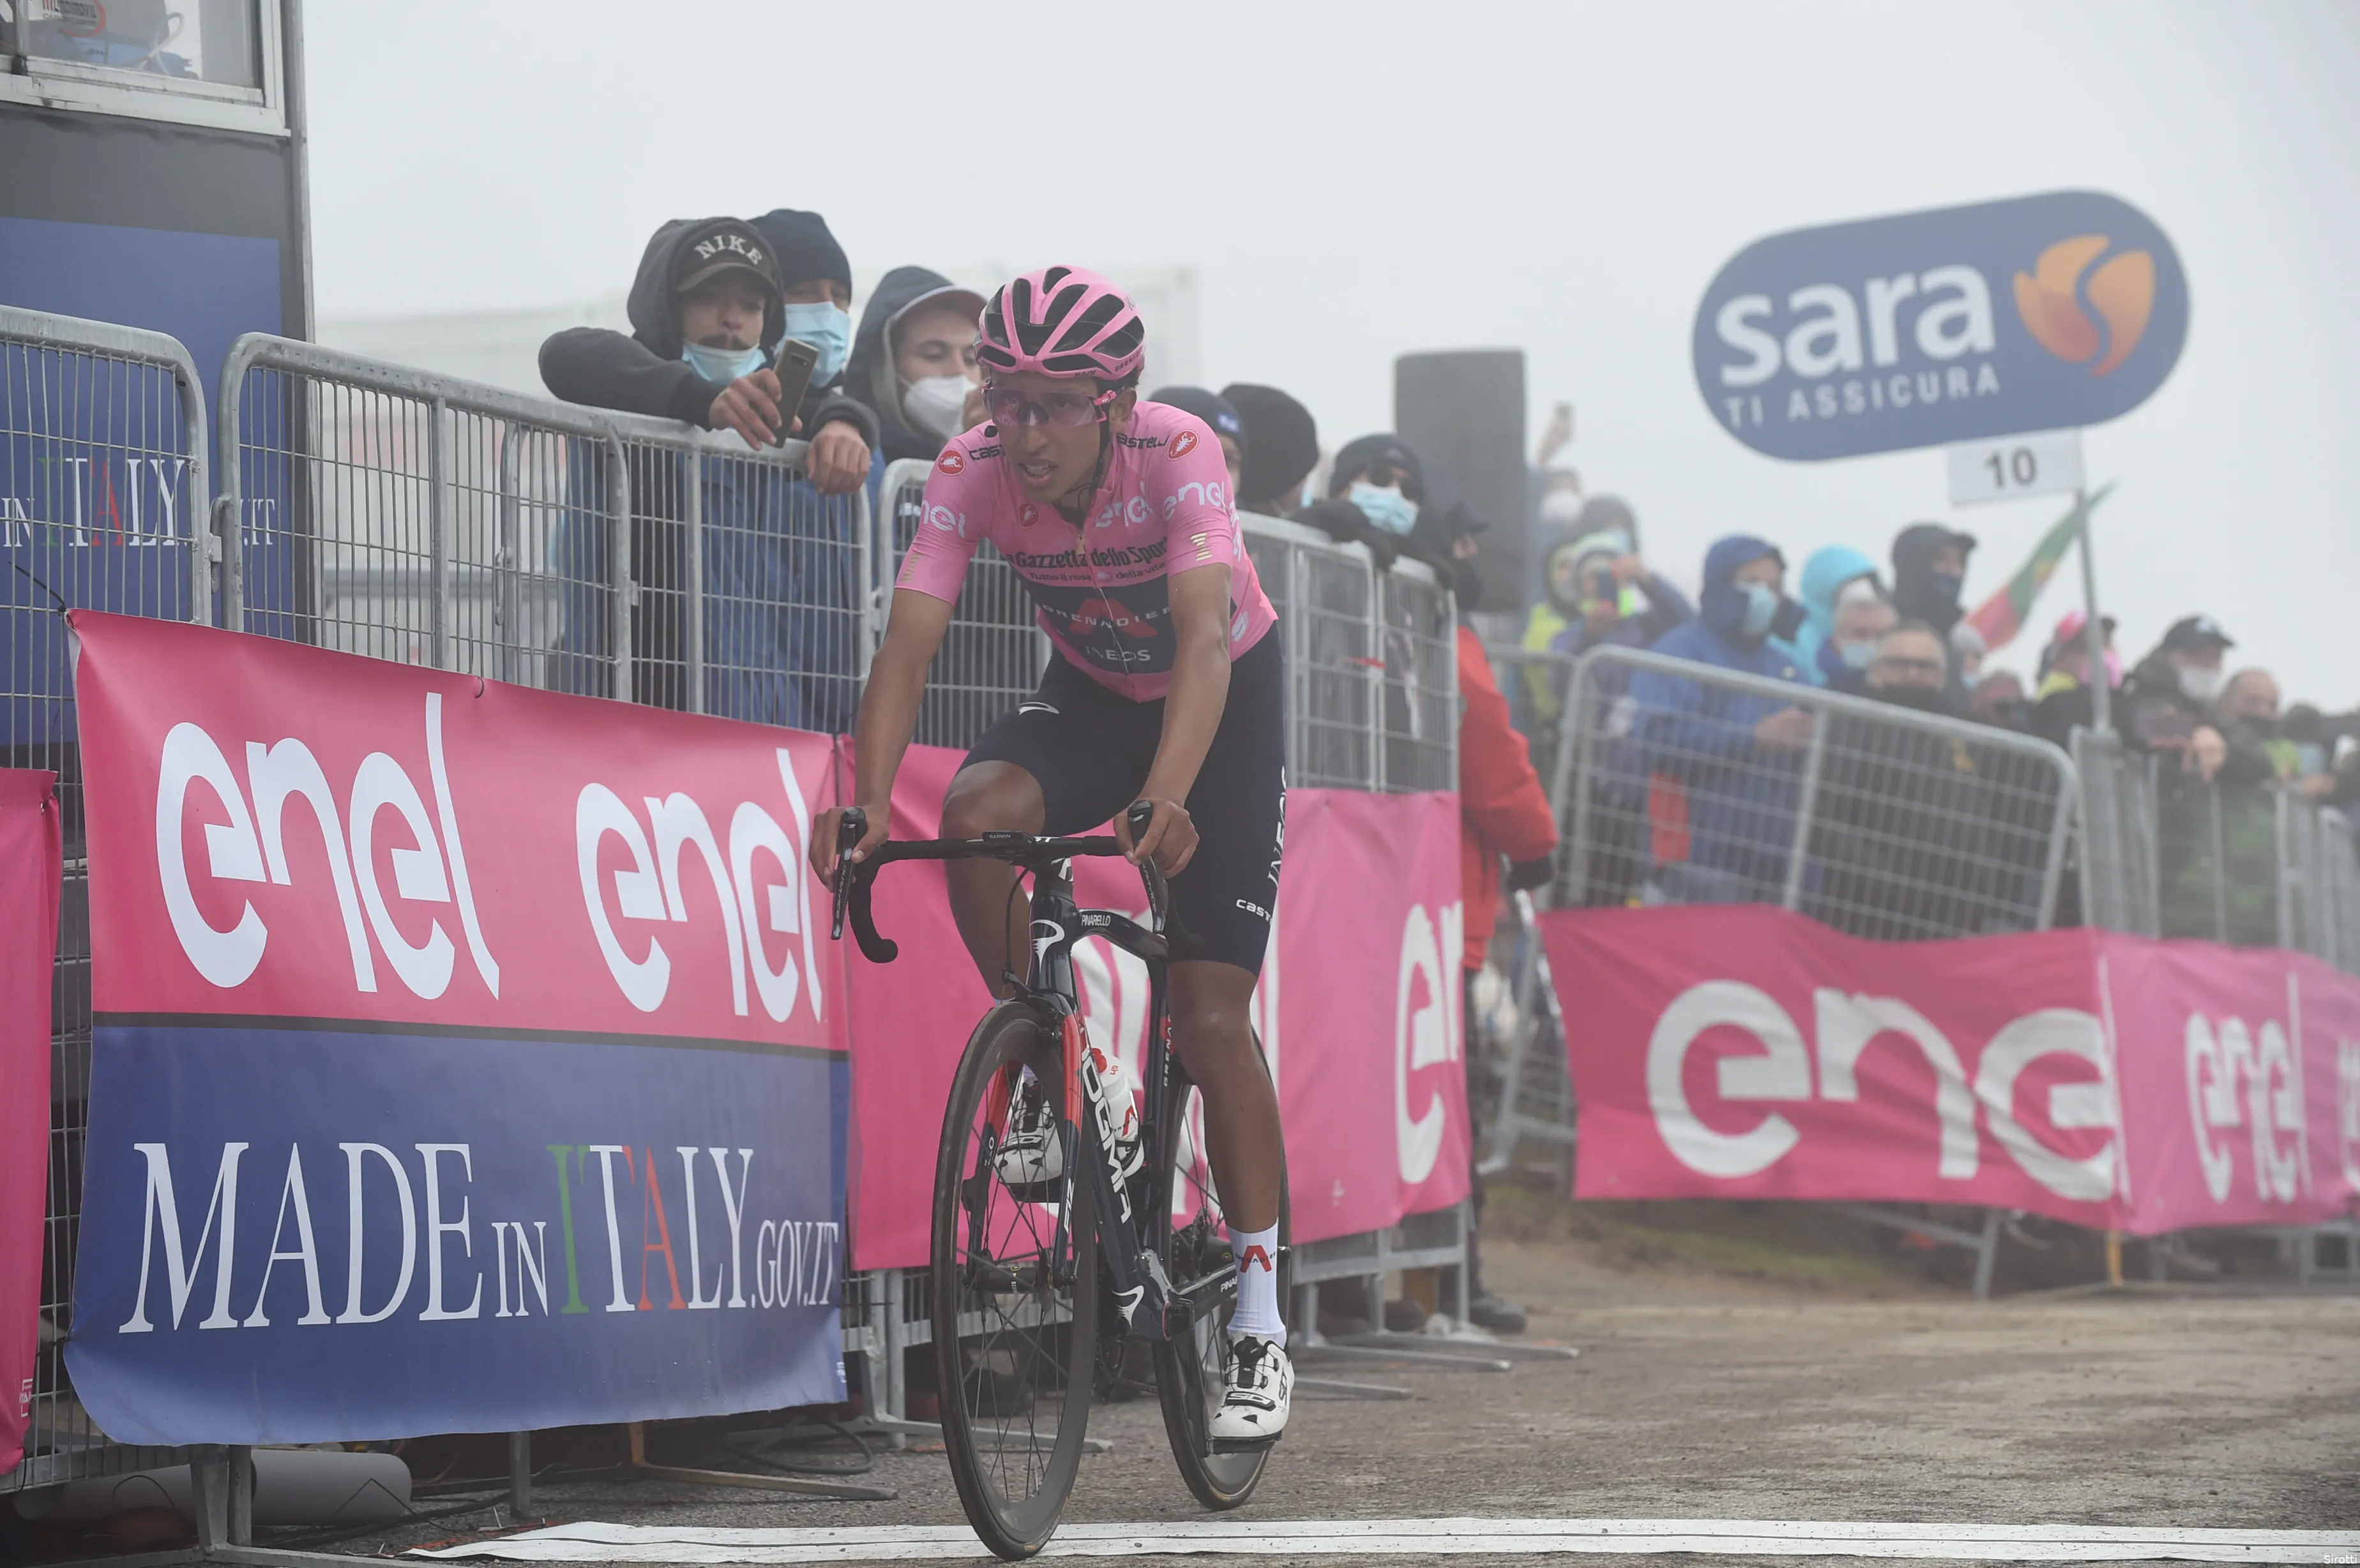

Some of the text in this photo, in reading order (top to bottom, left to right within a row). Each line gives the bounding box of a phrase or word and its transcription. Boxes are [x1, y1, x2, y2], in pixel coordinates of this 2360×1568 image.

[693, 234, 762, 266] NIKE
[1715, 263, 1995, 387] sara
[1725, 363, 2001, 430] TI ASSICURA
[1984, 447, 2037, 490] 10
[921, 500, 965, 538] nel
[1014, 550, 1089, 568] Gazzetta
[1091, 547, 1131, 567] dello
[1128, 536, 1167, 564] Spor
[1116, 570, 1144, 579] della
[156, 691, 822, 1023] enel enel
[1081, 915, 1111, 926] PINARELLO
[1236, 898, 1273, 925] cast
[2184, 971, 2313, 1205] enel
[119, 1142, 481, 1333] MADE
